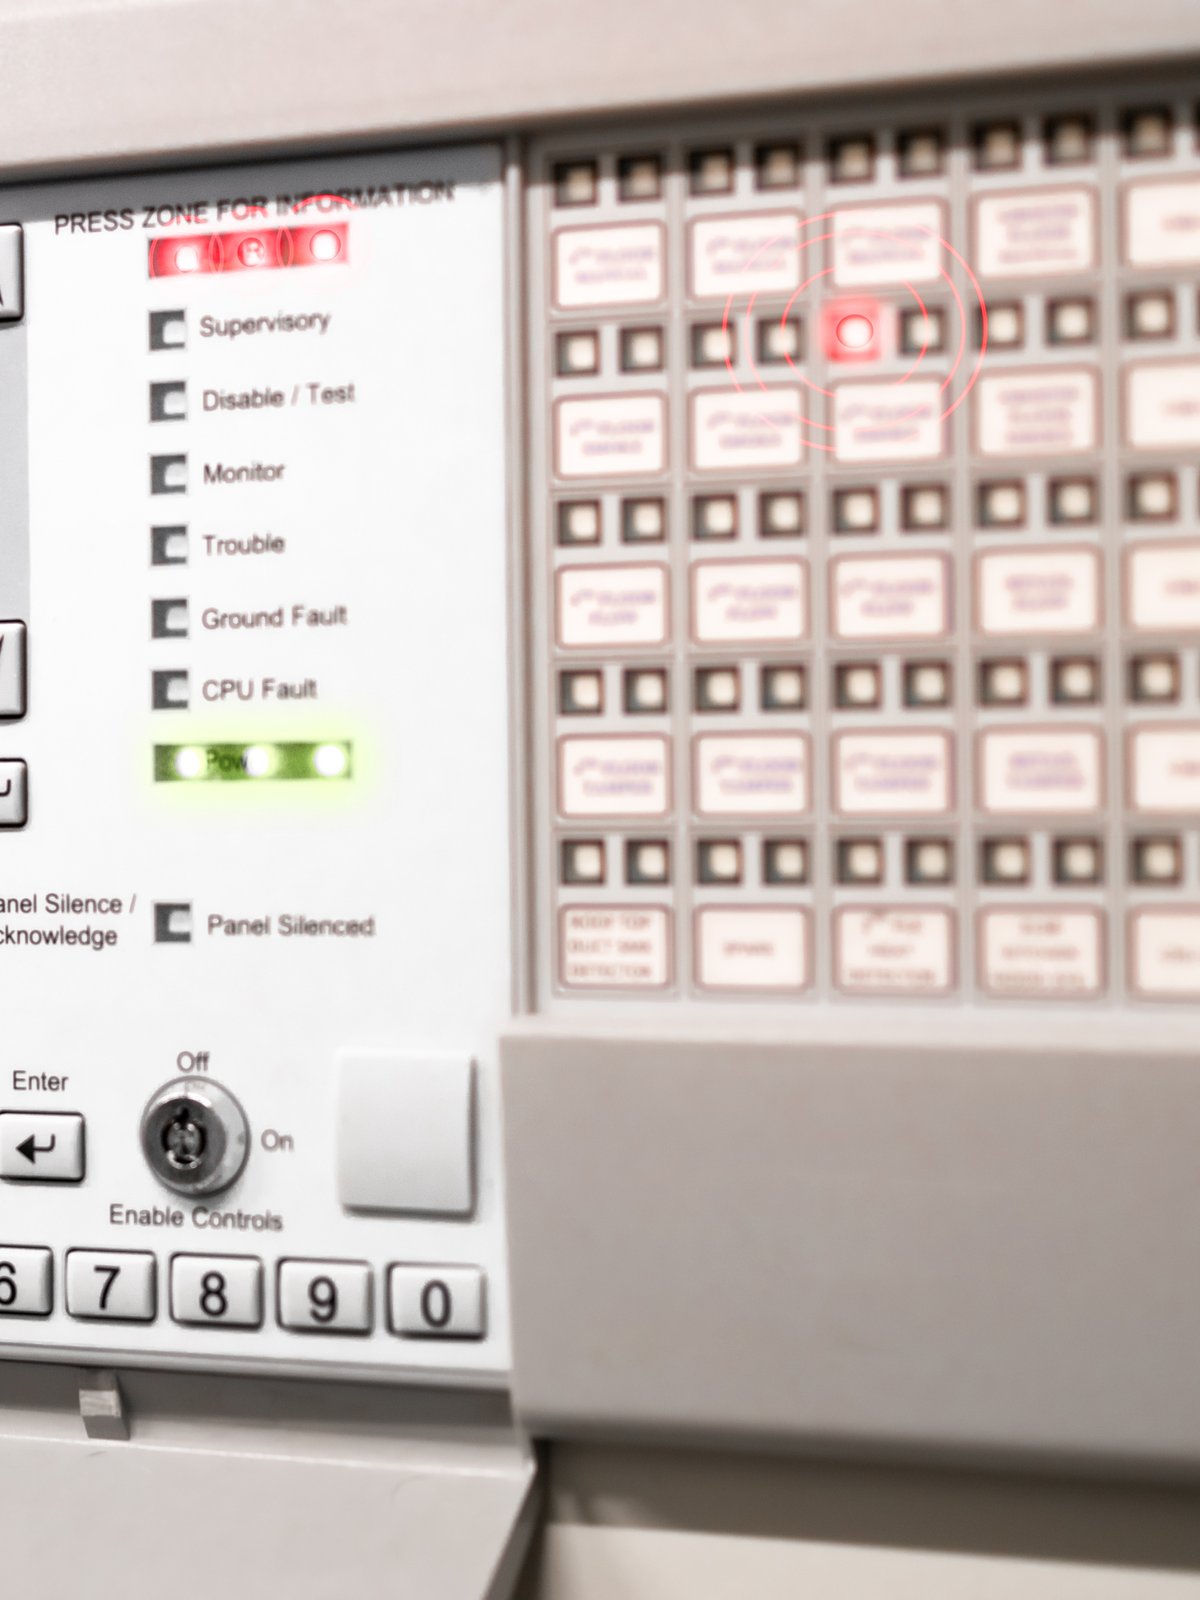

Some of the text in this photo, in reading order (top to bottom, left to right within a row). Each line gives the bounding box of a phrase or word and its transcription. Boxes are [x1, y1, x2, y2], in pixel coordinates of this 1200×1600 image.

[54, 212, 135, 235] PRESS
[141, 203, 208, 229] ZONE
[216, 197, 270, 222] FOR
[199, 311, 331, 339] Supervisory
[203, 390, 285, 412] Disable
[307, 382, 356, 405] Test
[203, 463, 285, 484] Monitor
[203, 533, 286, 555] Trouble
[201, 604, 348, 630] Ground Fault
[201, 677, 318, 702] CPU Fault
[44, 892, 123, 915] Silence
[207, 914, 375, 937] Panel Silenced
[176, 1050, 210, 1073] Off
[12, 1070, 69, 1092] Enter
[260, 1128, 295, 1152] On
[109, 1203, 284, 1233] Enable Controls
[93, 1265, 122, 1310] 7
[199, 1271, 228, 1317] 8
[307, 1277, 340, 1323] 9
[420, 1279, 453, 1328] 0
